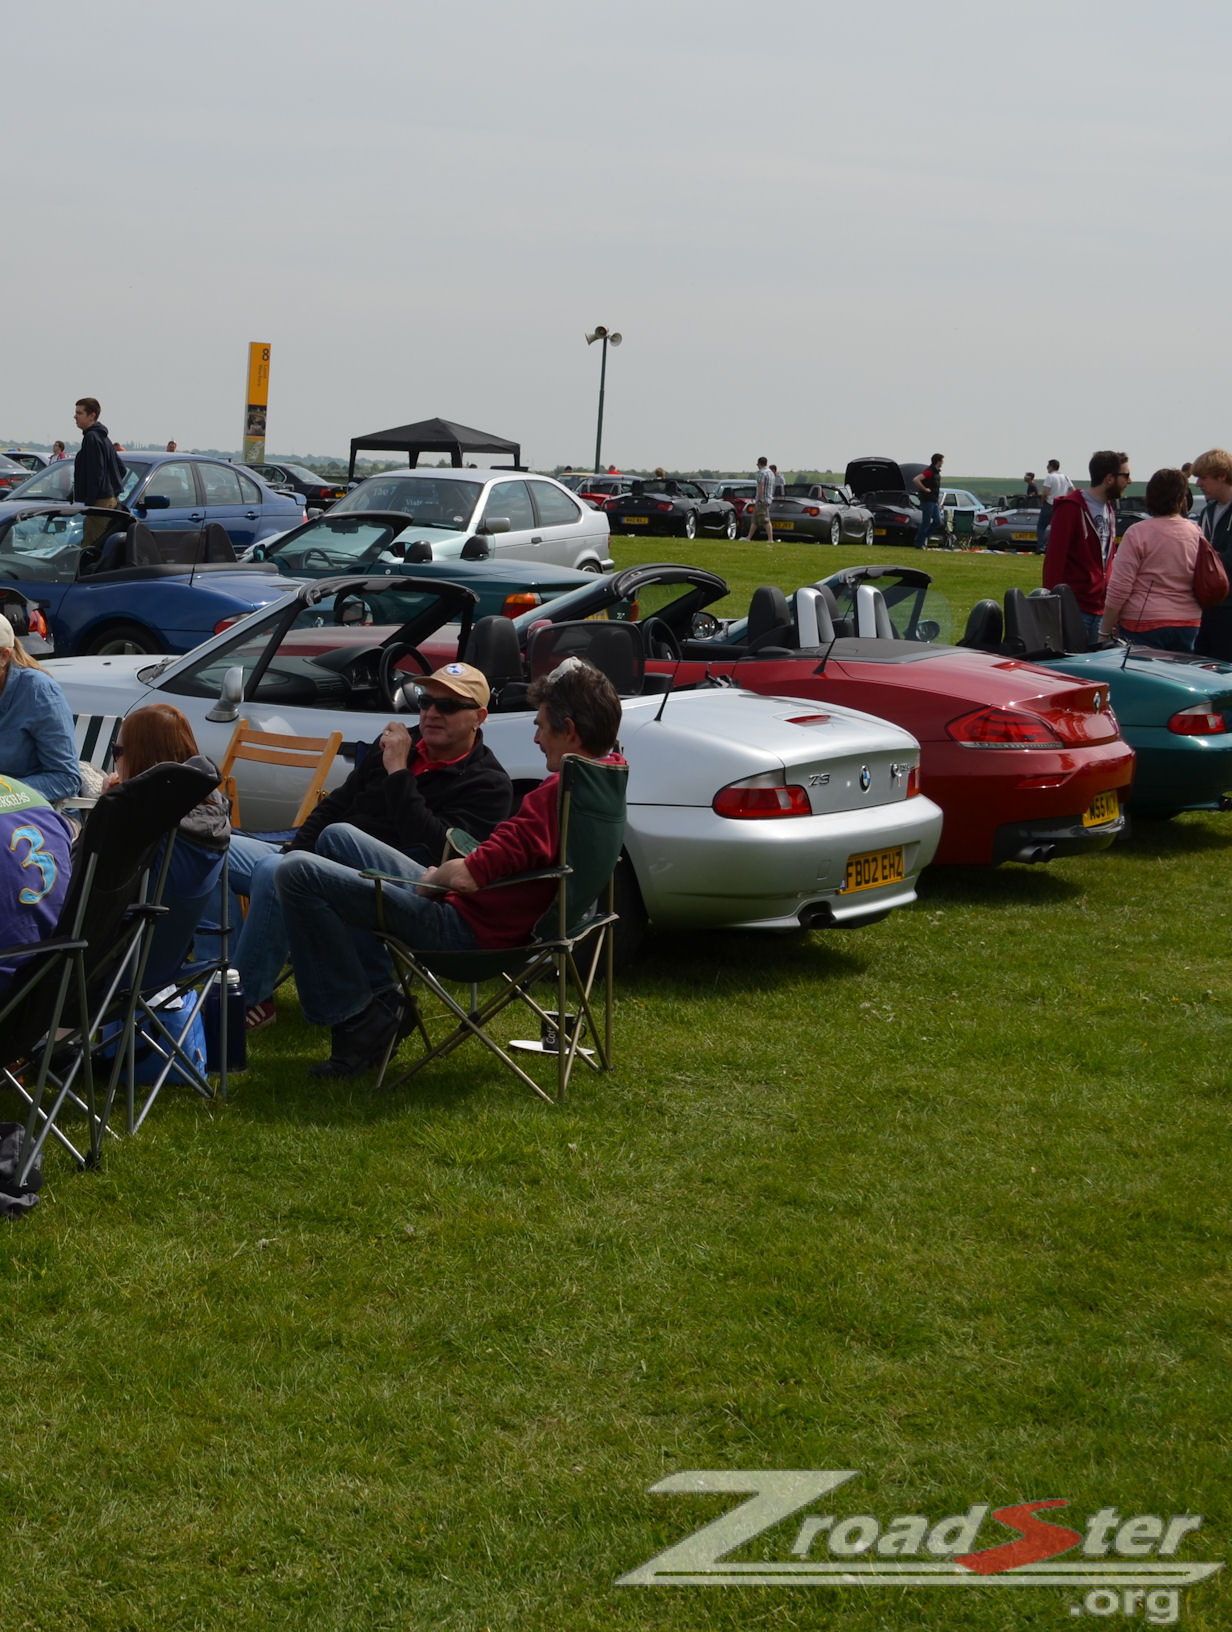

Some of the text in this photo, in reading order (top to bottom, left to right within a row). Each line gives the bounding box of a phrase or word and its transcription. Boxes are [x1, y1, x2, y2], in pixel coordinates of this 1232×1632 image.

[262, 348, 270, 361] 8
[808, 772, 830, 787] Z3
[10, 825, 58, 904] 3
[846, 851, 903, 888] FB02 EHZ
